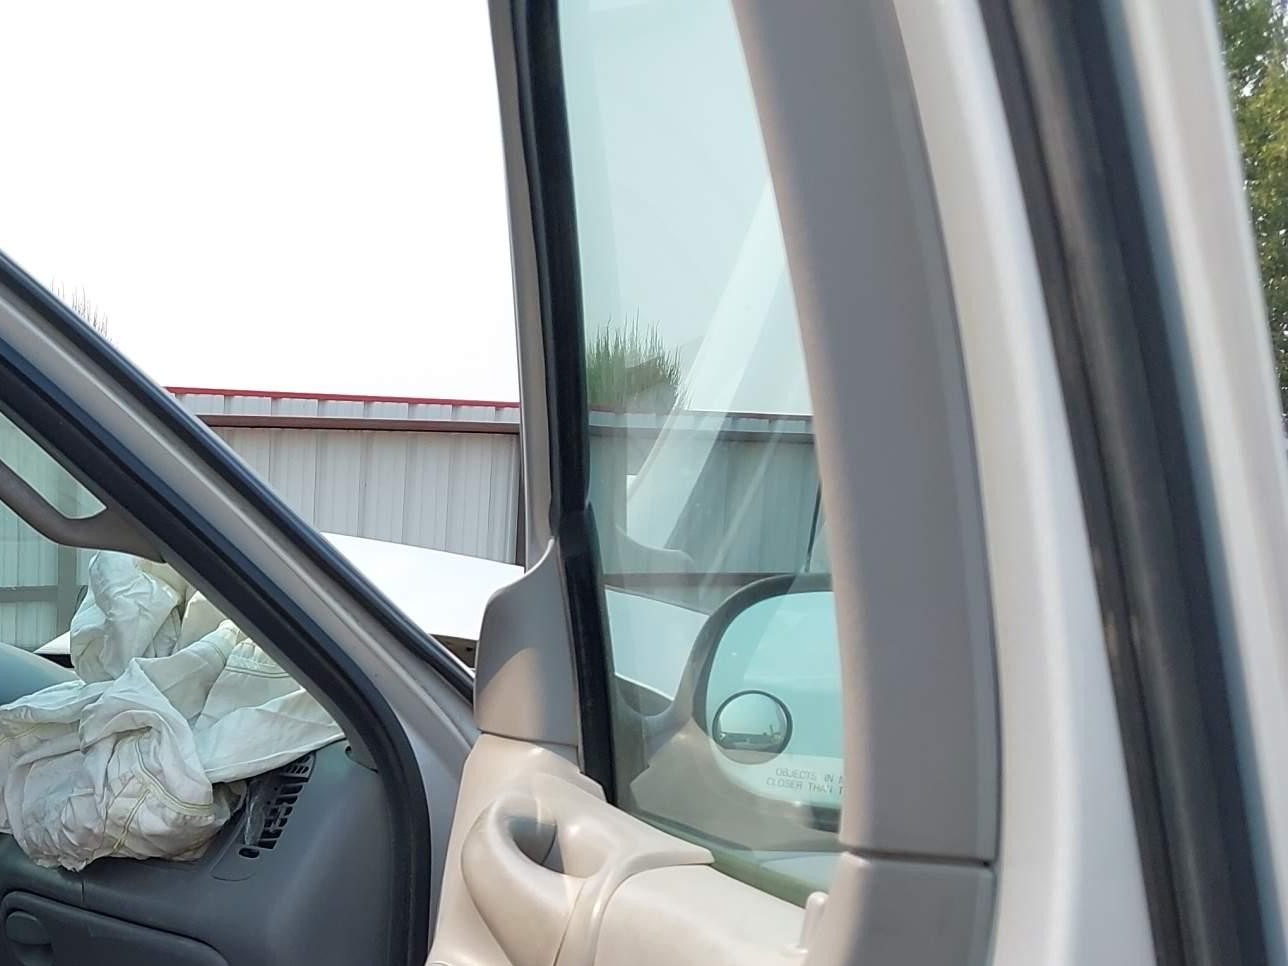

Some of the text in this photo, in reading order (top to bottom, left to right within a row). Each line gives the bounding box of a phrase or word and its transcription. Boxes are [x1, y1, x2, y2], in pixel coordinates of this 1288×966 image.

[775, 767, 817, 781] OBJECTS
[824, 773, 834, 783] IN
[766, 776, 802, 791] CLOSER
[808, 782, 833, 793] THAN
